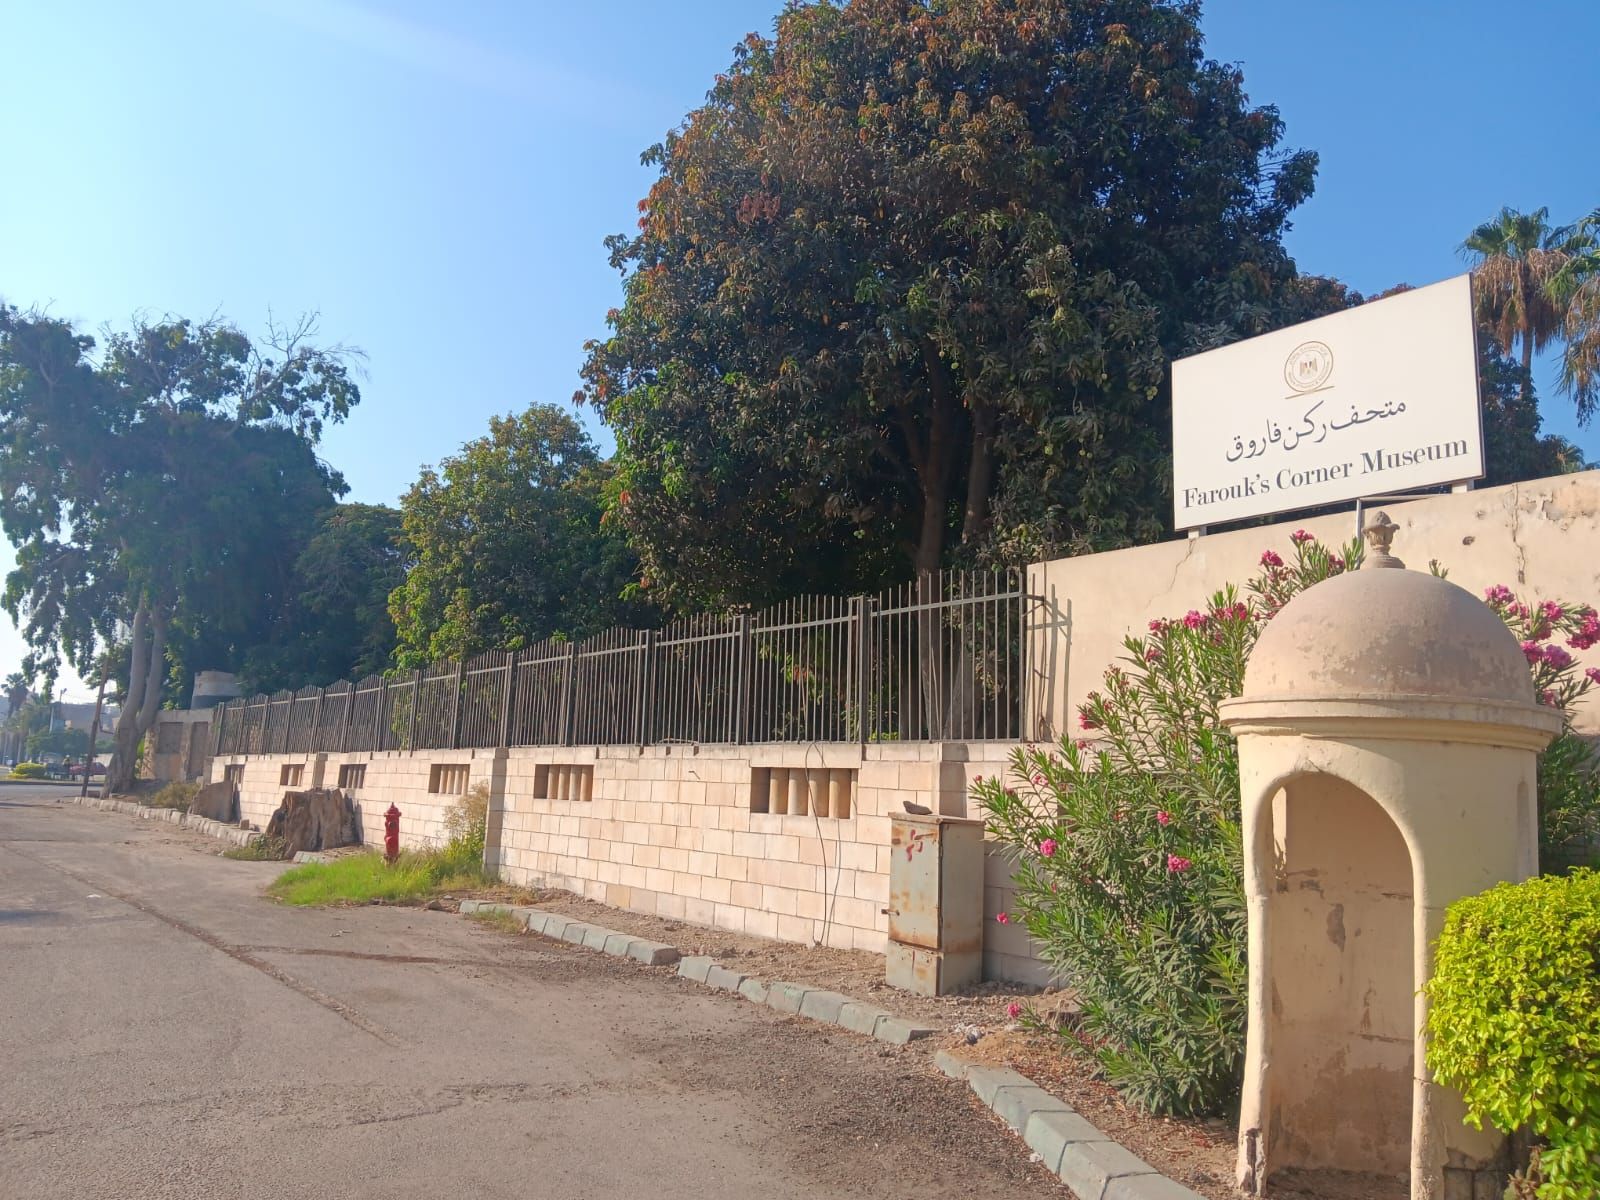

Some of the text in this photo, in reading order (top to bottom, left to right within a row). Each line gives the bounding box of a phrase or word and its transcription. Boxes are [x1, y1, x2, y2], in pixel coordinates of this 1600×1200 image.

[1226, 400, 1407, 463] متحف ركن فاروق
[1183, 439, 1469, 509] Farouk's Corner Museum
